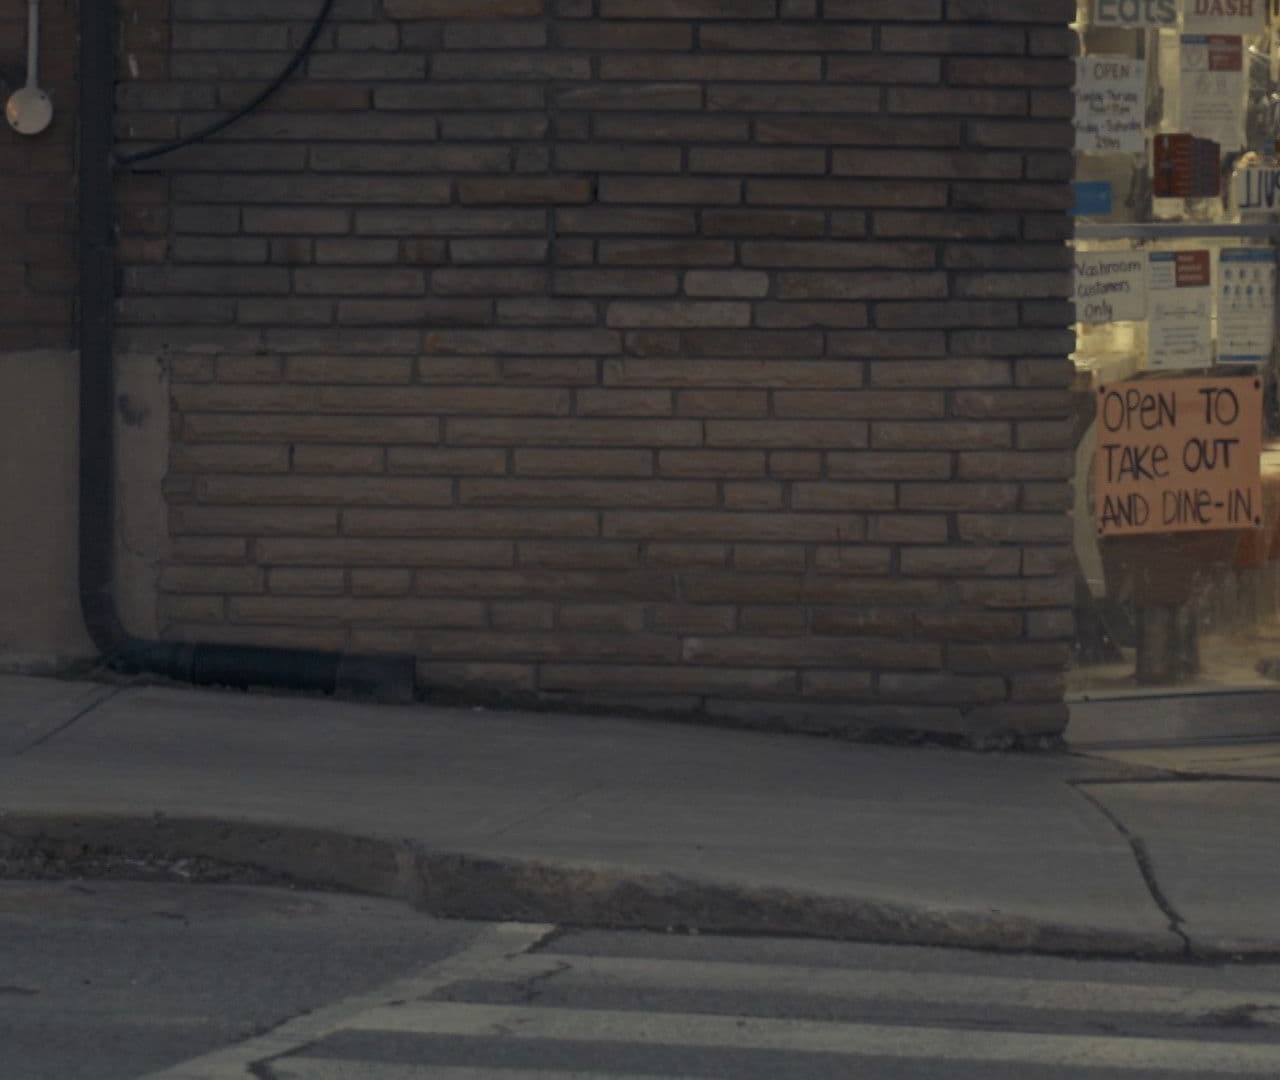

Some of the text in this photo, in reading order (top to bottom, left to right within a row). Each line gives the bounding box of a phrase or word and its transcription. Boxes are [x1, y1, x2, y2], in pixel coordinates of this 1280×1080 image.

[1198, 387, 1240, 425] TO
[1183, 438, 1239, 472] OUT
[1101, 494, 1150, 528] AND
